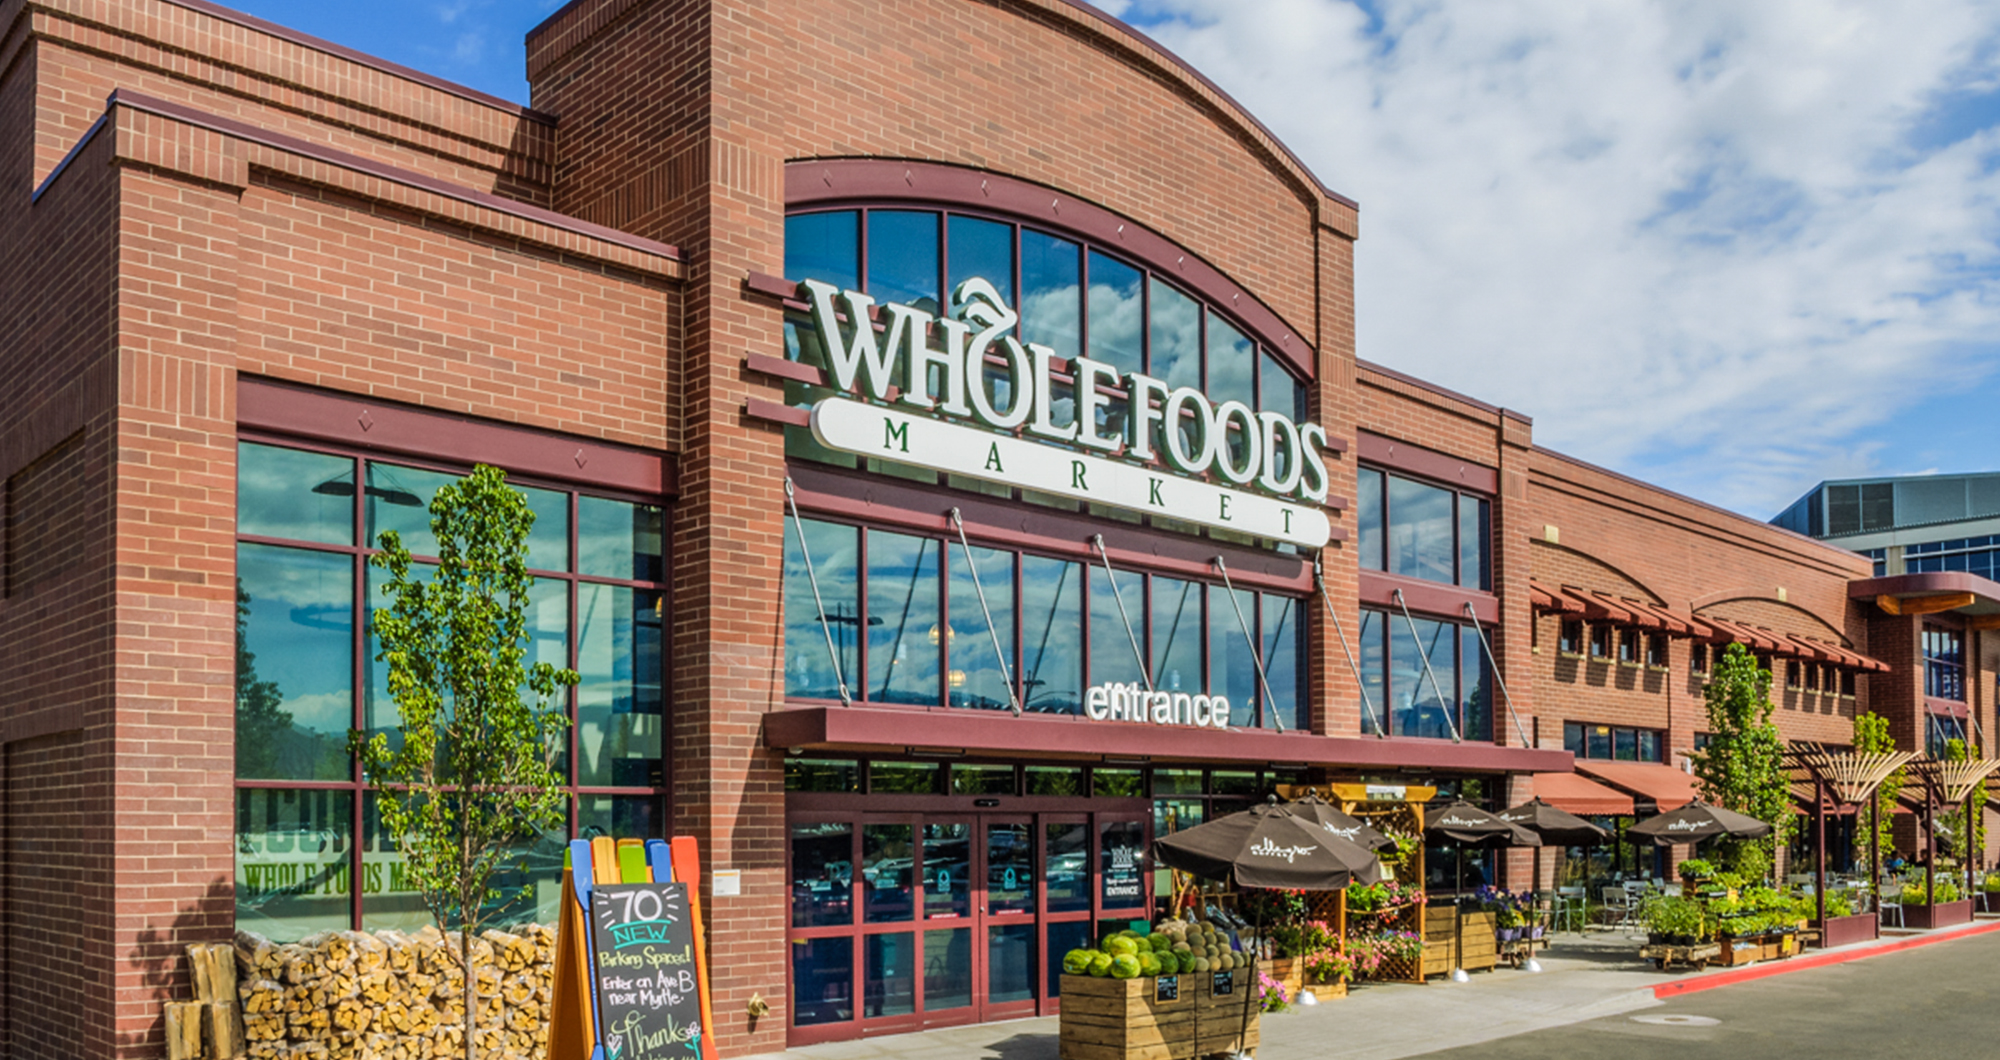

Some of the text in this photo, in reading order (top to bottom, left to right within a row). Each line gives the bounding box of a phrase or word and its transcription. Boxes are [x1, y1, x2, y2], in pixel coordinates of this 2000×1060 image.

[800, 277, 1329, 504] WHOLE FOODS
[883, 417, 1295, 536] MARKET
[1085, 681, 1230, 730] entrance
[1250, 837, 1317, 864] allegro
[243, 862, 316, 896] WHOLE
[323, 862, 382, 895] FODS
[610, 889, 662, 924] 70
[613, 925, 667, 944] NEW
[599, 945, 691, 970] Parking Spaces!
[602, 969, 695, 993] Enter on Ave B
[608, 993, 637, 1006] near
[611, 1010, 689, 1057] Thanks
